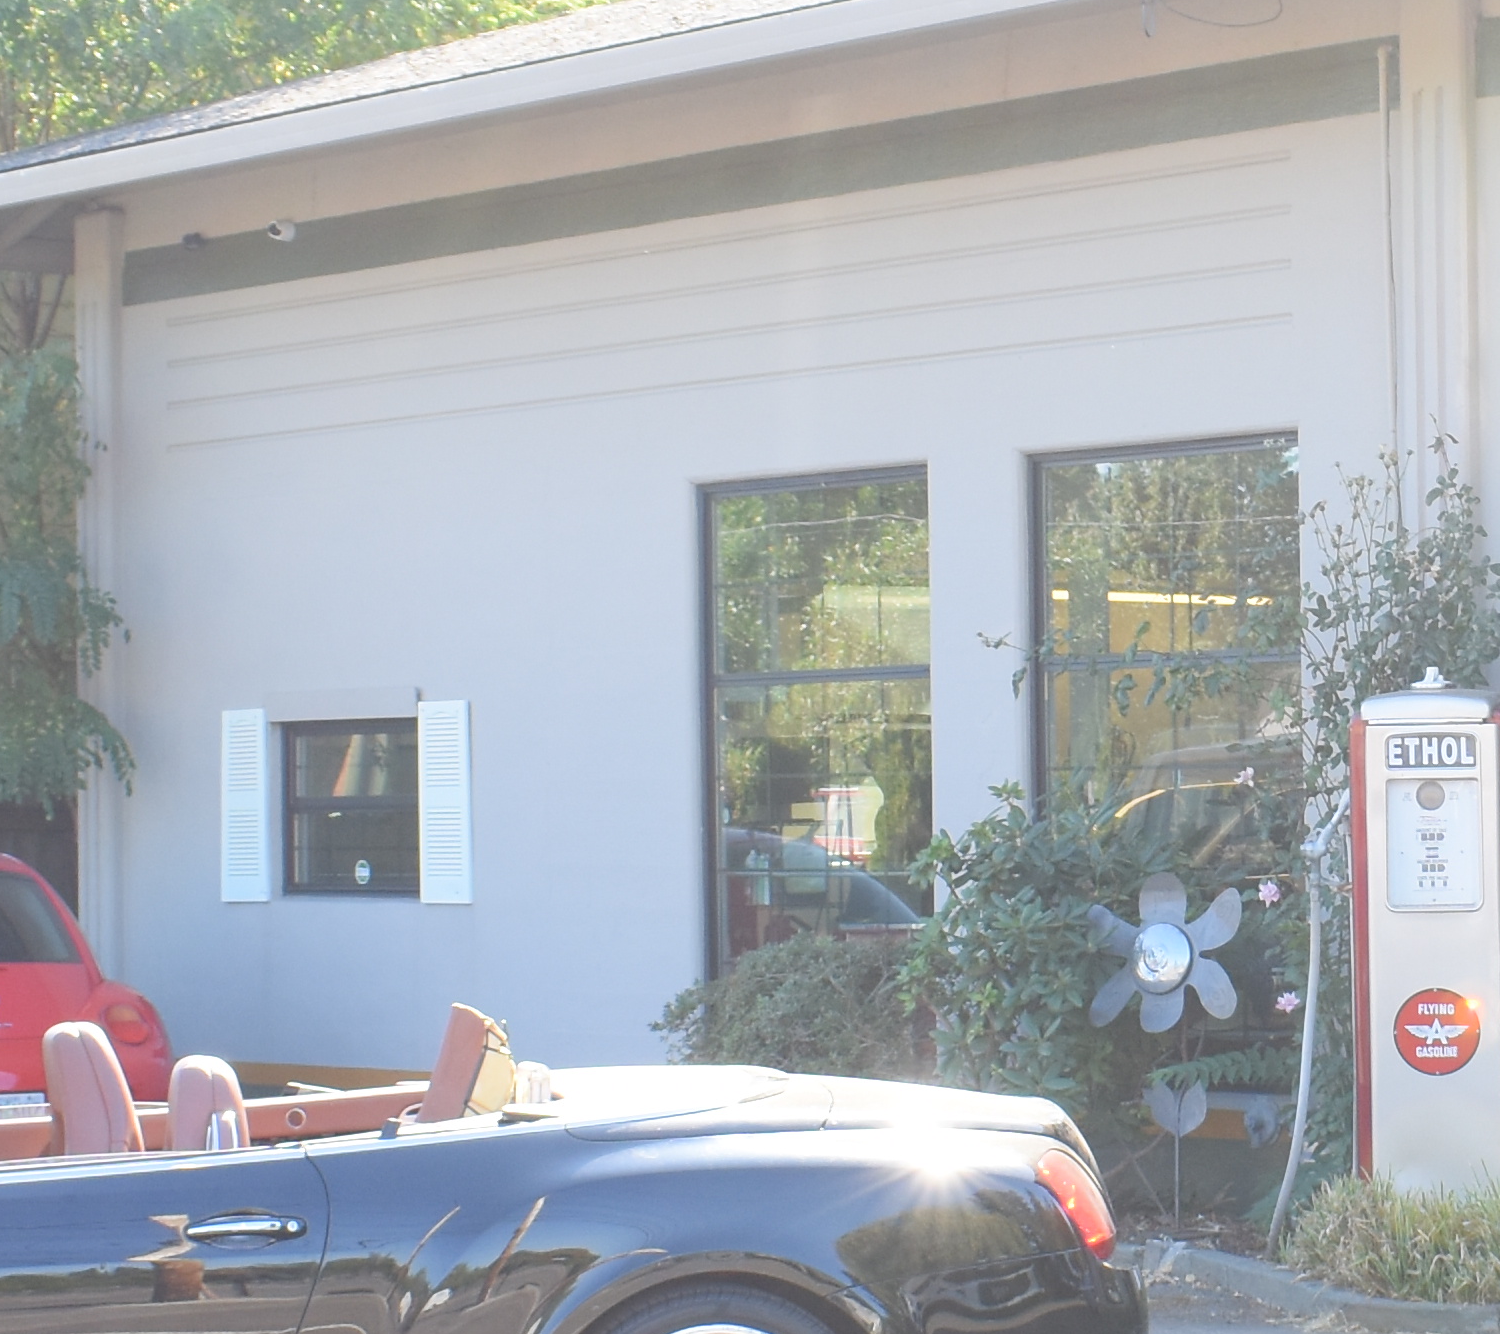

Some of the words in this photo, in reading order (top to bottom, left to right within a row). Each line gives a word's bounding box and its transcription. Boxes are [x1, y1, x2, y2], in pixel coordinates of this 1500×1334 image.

[1388, 736, 1475, 766] ETHOL
[1418, 1003, 1455, 1015] FLYING
[1416, 1046, 1458, 1058] GASOLINE
